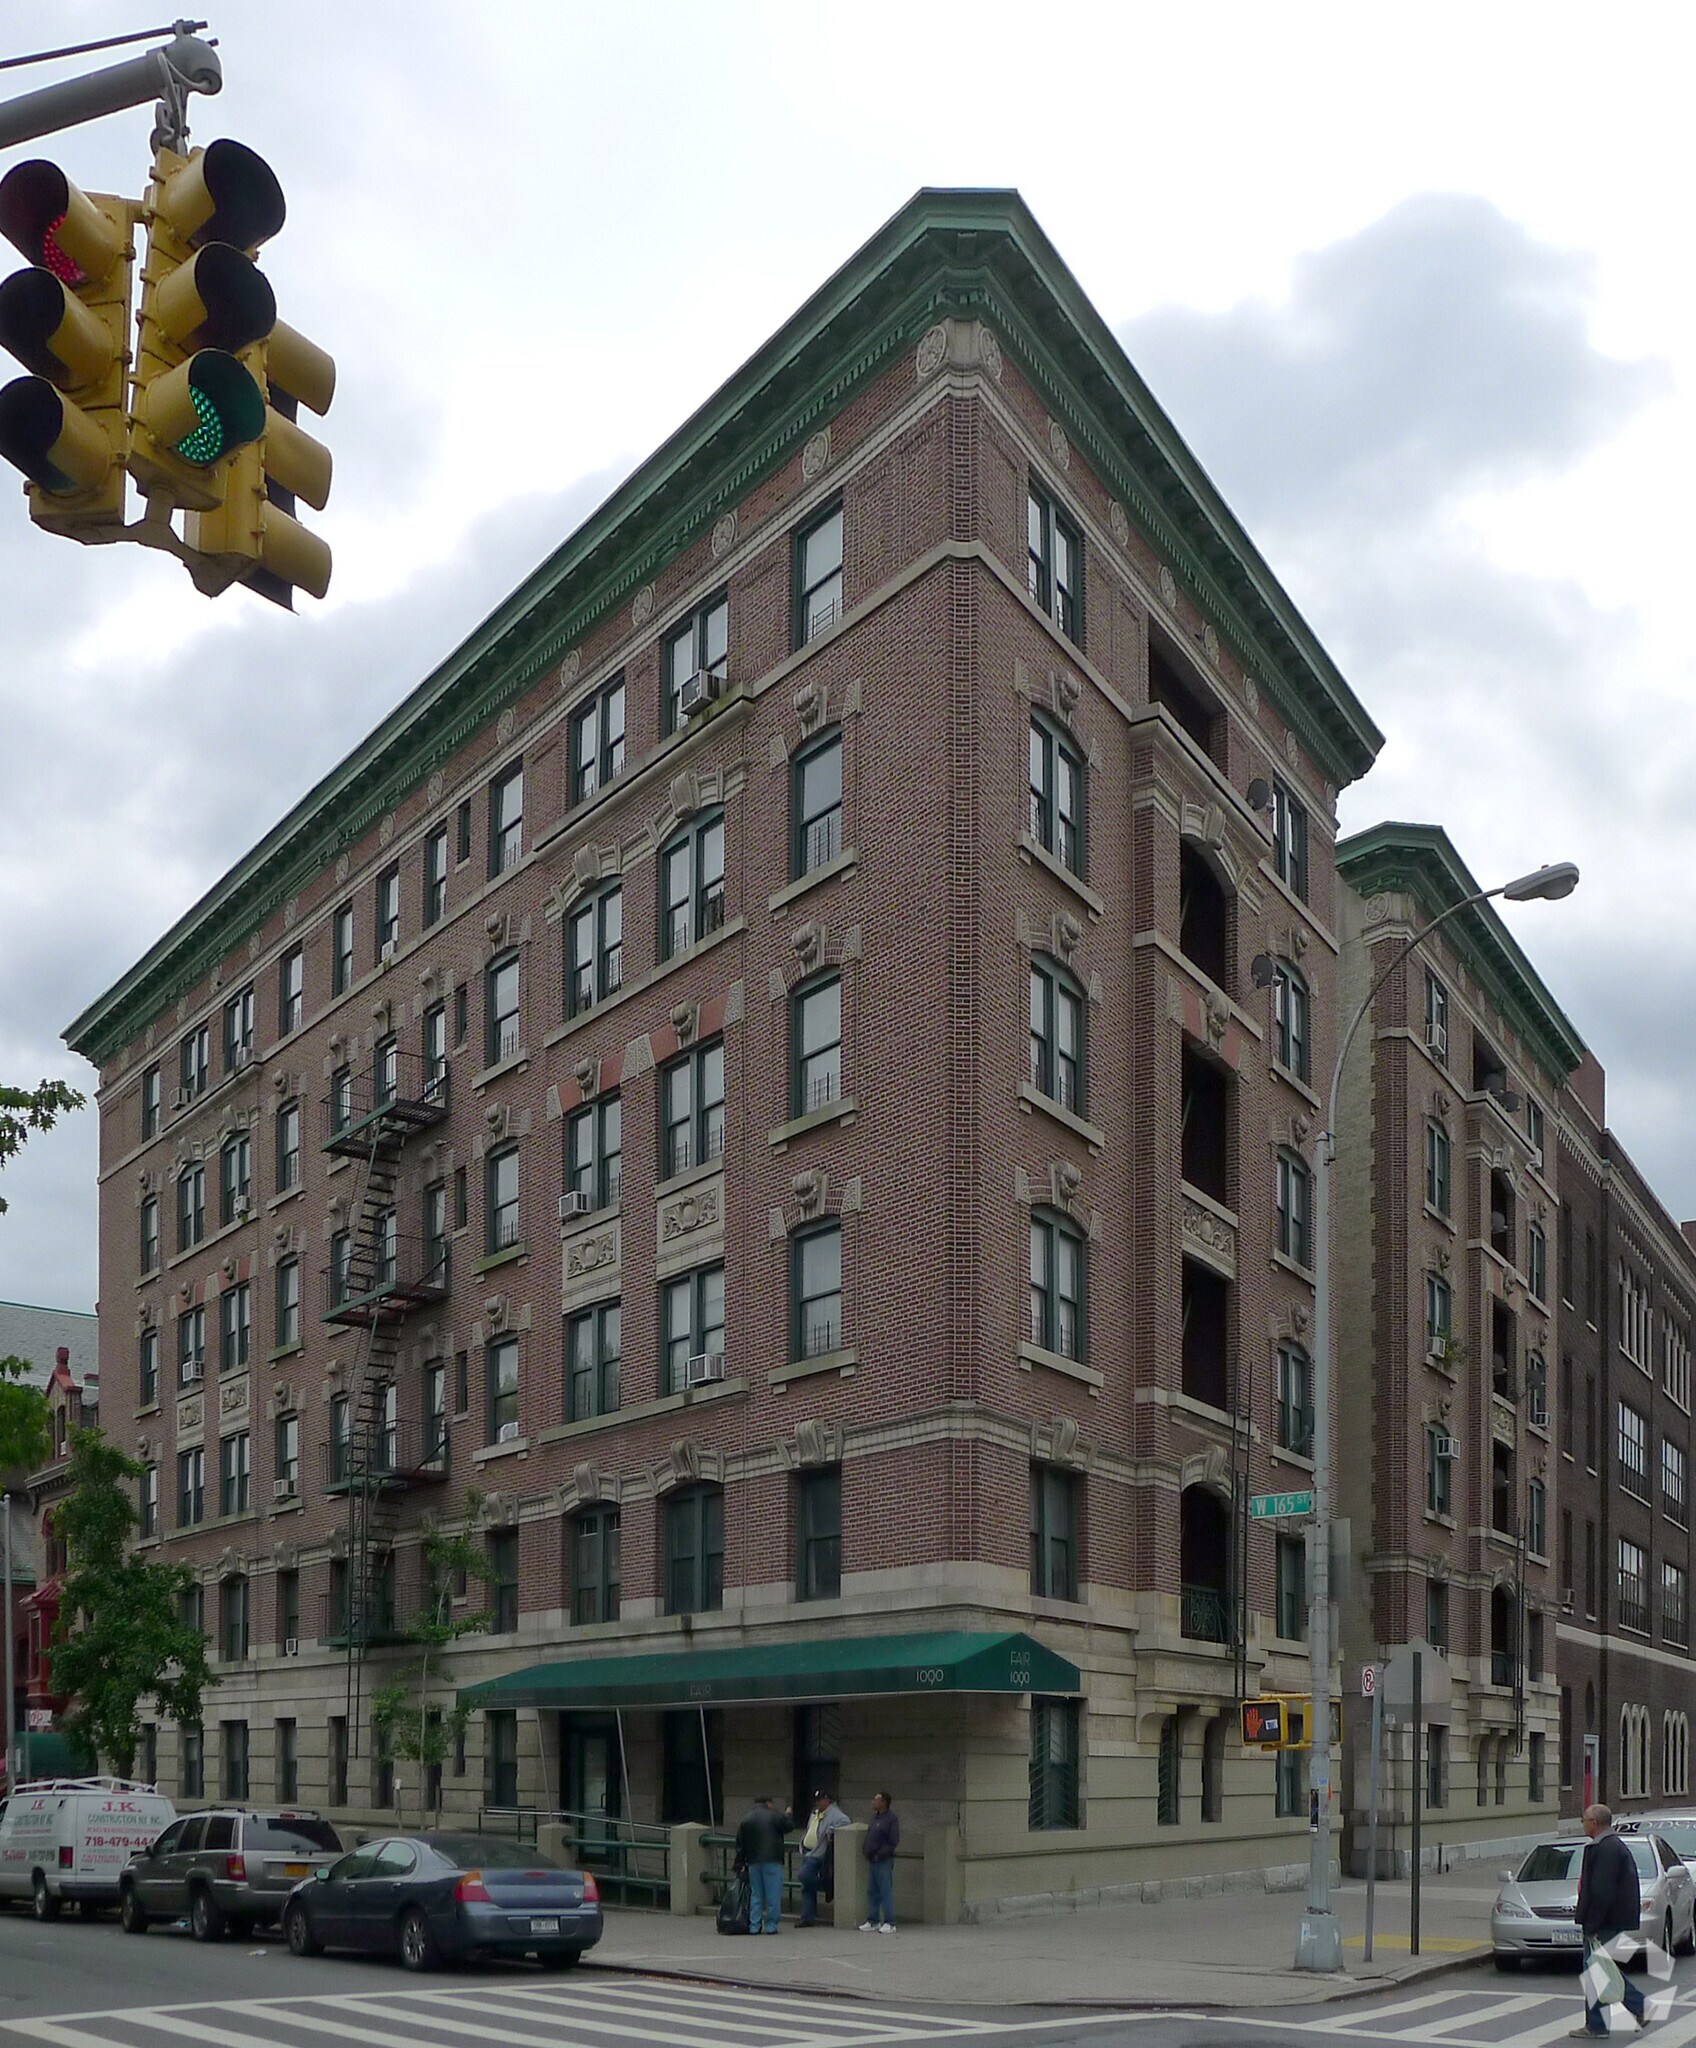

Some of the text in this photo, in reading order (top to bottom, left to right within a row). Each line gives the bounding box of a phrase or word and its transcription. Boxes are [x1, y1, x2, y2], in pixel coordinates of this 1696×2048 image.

[1256, 1494, 1308, 1515] W 165 ST
[1010, 1651, 1030, 1666] FAIR
[916, 1669, 944, 1685] 1090
[1010, 1671, 1030, 1687] 1090
[102, 1801, 142, 1812] J.K.
[85, 1836, 155, 1847] 718-479-444
